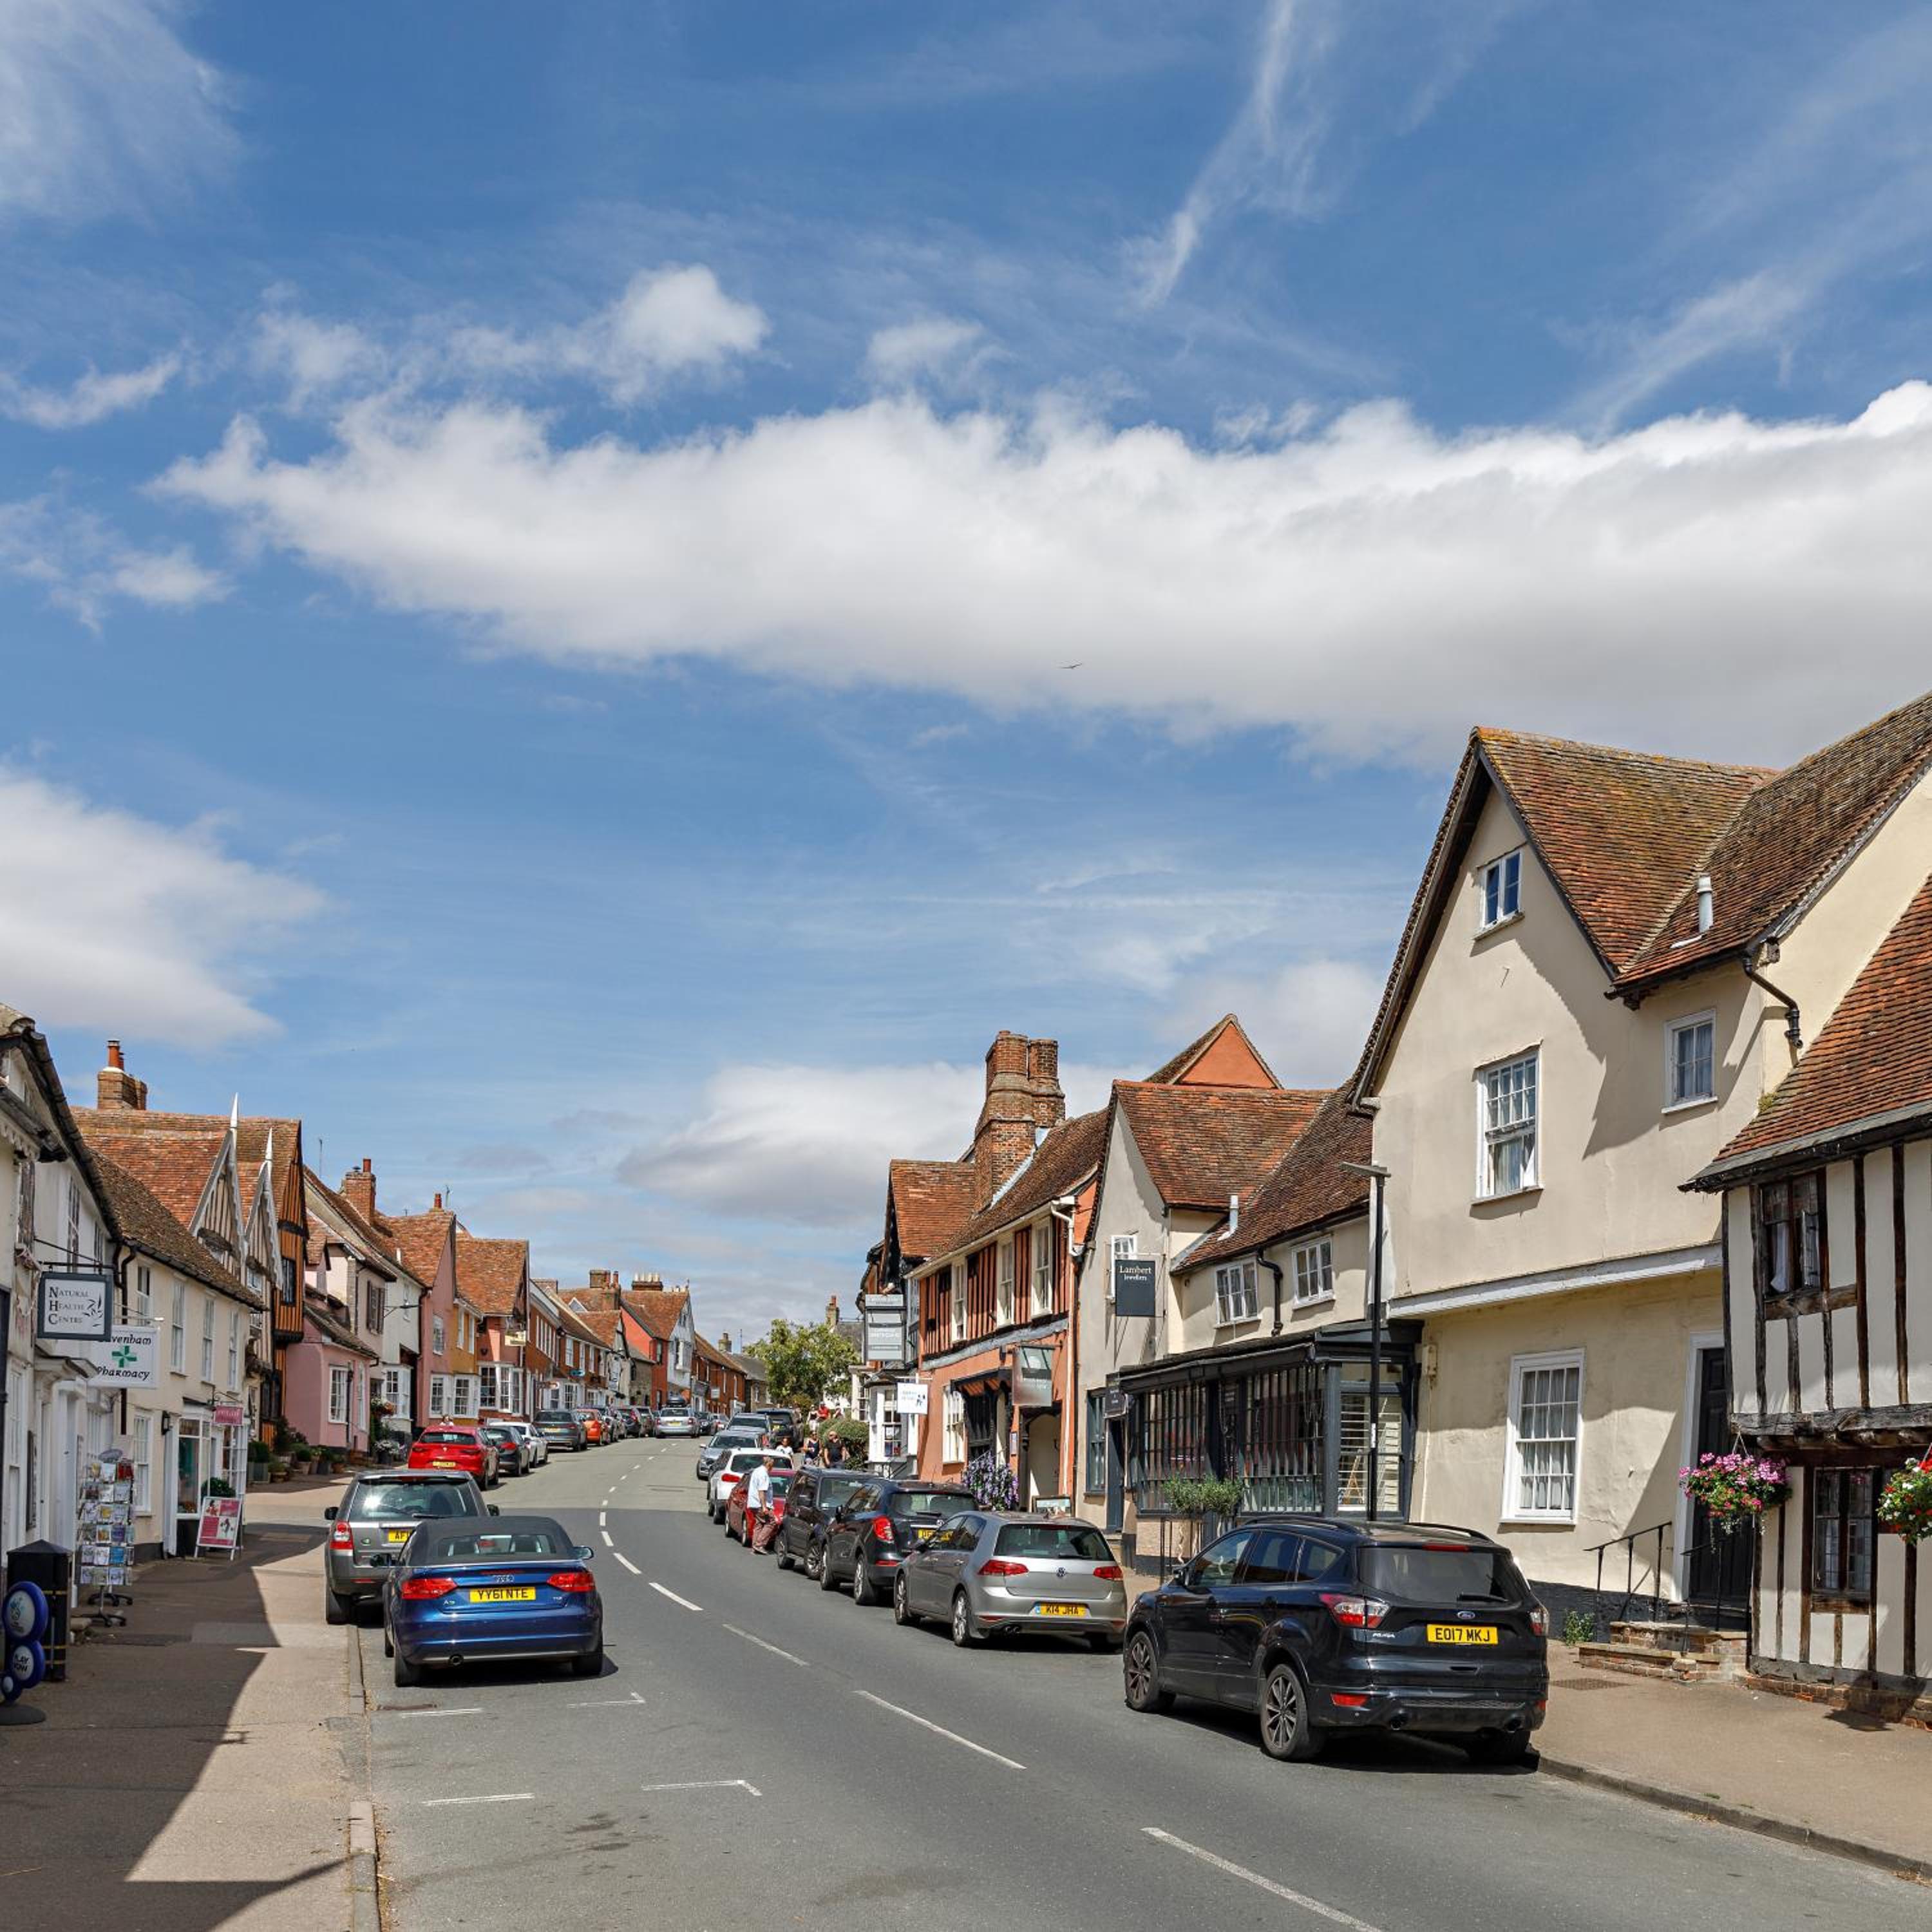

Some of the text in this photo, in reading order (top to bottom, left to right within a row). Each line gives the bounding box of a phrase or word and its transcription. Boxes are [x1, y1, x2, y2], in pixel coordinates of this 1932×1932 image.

[1119, 1265, 1151, 1274] Lambert
[48, 1314, 83, 1325] CENTRE
[97, 1366, 150, 1381] Pharmacy
[478, 1587, 529, 1600] YY61 NTE
[1466, 1629, 1490, 1642] MKJ
